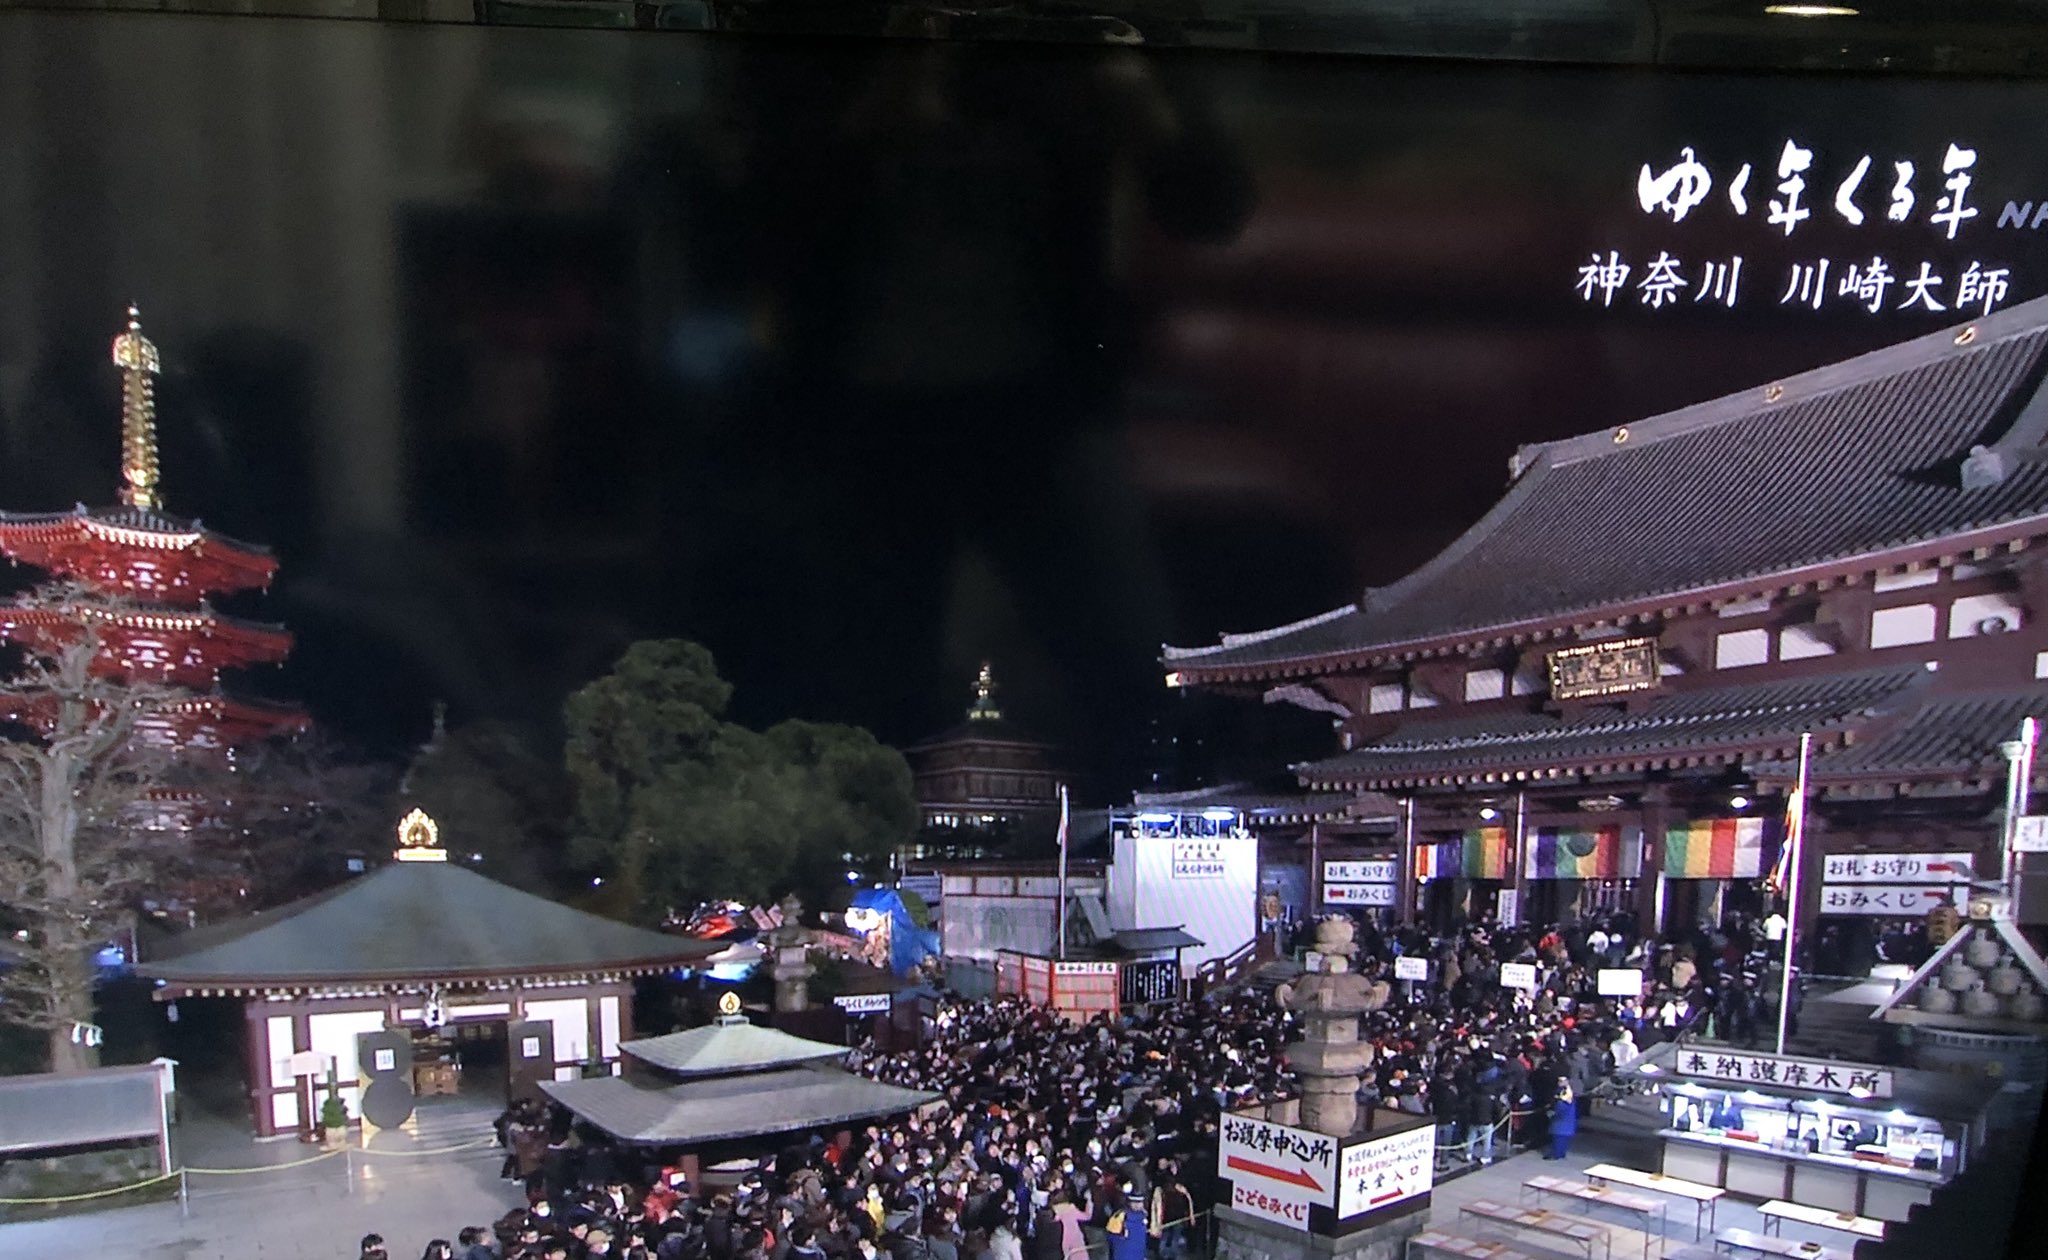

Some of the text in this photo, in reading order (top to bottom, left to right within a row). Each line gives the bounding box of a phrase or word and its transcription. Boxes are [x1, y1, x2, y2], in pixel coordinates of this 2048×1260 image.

[1638, 138, 1978, 239] ゆく年くる年
[1574, 250, 2011, 316] 神奈川 川崎大師
[1346, 887, 1392, 900] おみくじ
[1827, 892, 1916, 908] おみくじ
[1686, 1053, 1881, 1093] 奉納護摩木所
[1224, 1118, 1333, 1169] お護摩申込所
[1235, 1187, 1307, 1221] こどもみくじ
